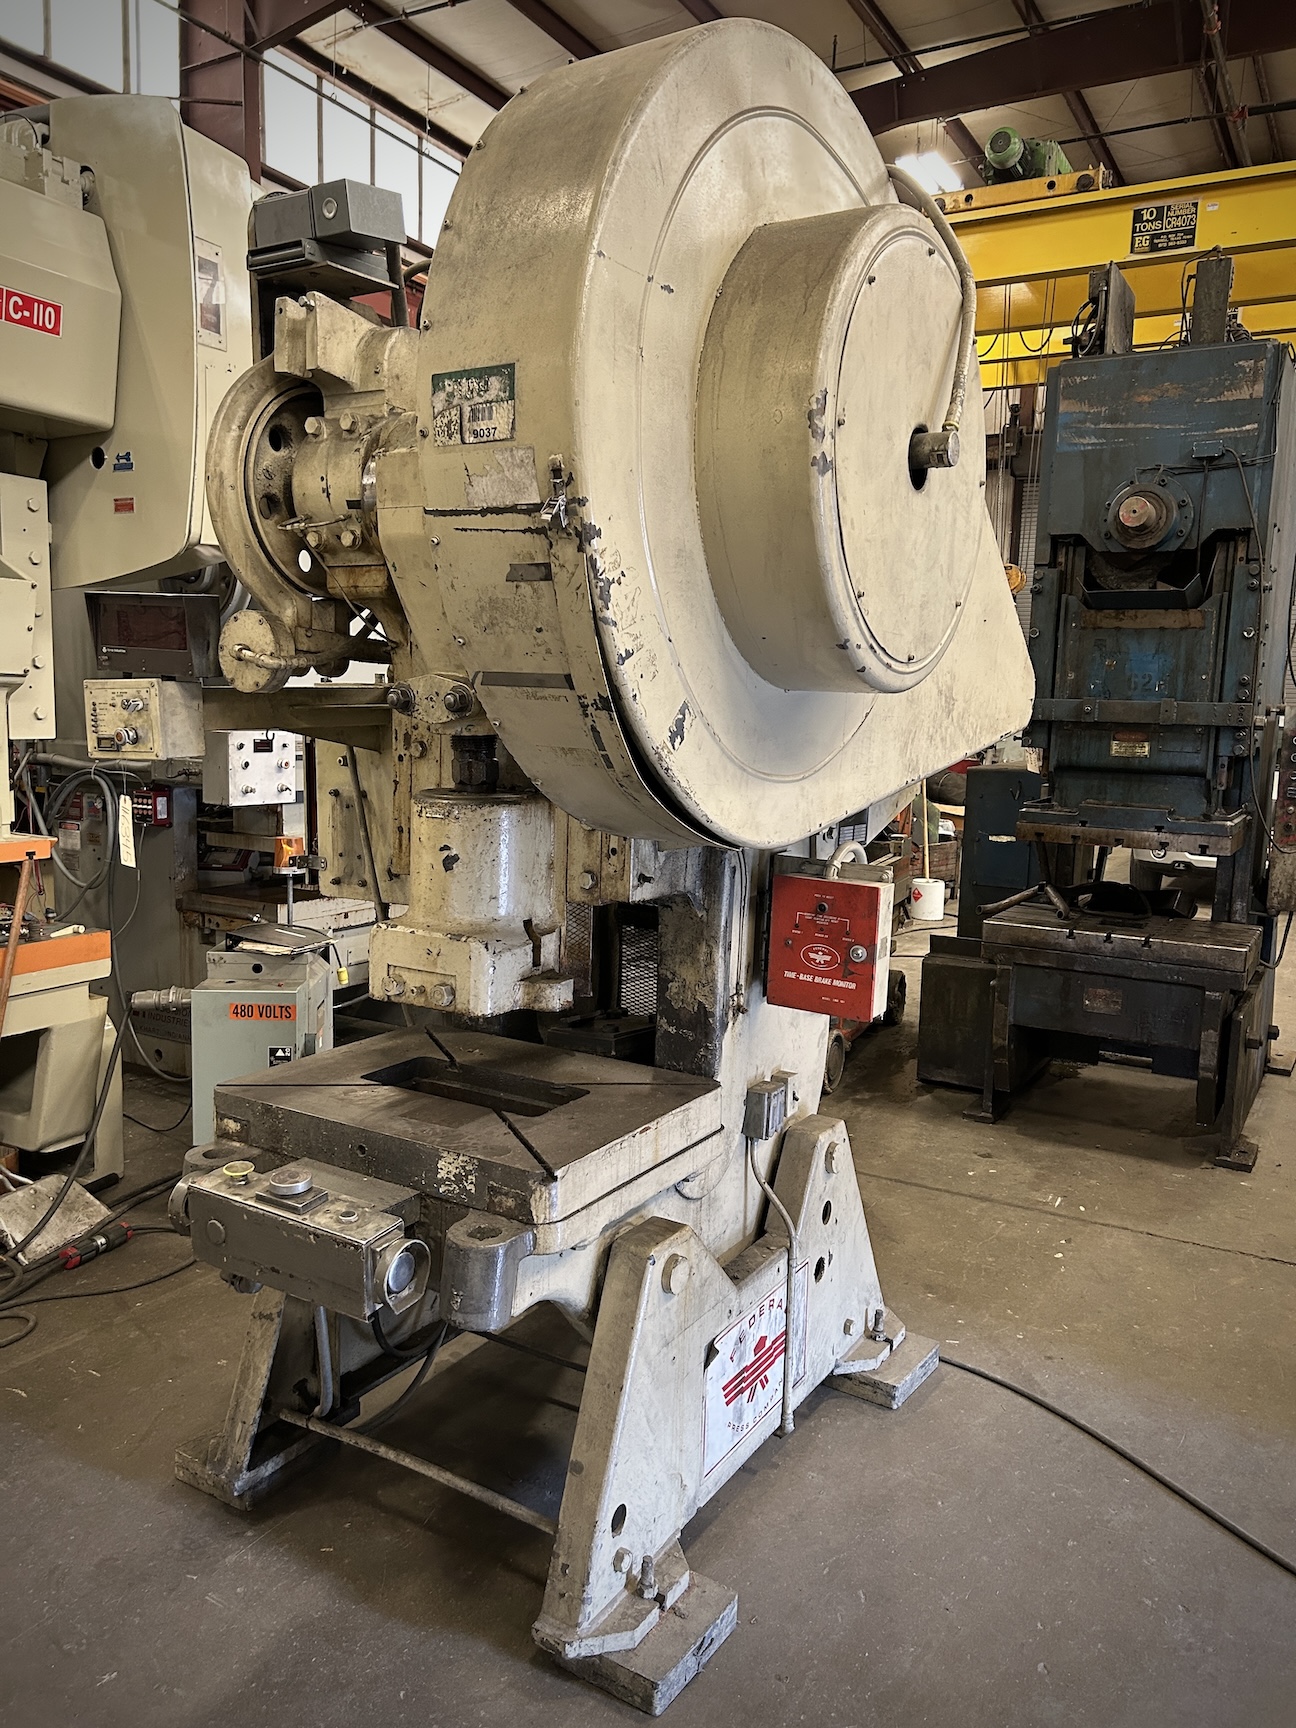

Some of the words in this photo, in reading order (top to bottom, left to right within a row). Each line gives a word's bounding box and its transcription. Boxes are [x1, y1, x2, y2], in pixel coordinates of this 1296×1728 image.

[1167, 207, 1196, 217] NUMBER
[1171, 202, 1193, 211] SERIAL
[1141, 208, 1157, 221] 10
[1166, 214, 1197, 229] CR4073
[1134, 220, 1162, 232] TONS
[9, 295, 55, 330] C-110
[473, 427, 498, 439] 9037
[814, 976, 832, 986] BRAKE
[832, 979, 857, 990] MONITOR
[232, 1004, 254, 1018] 480
[258, 1005, 292, 1019] VOLTS
[148, 1011, 190, 1028] INDUSTRIE
[729, 1298, 786, 1363] FEDERA
[727, 1420, 750, 1434] PRESS
[752, 1377, 784, 1424] COMPAN
